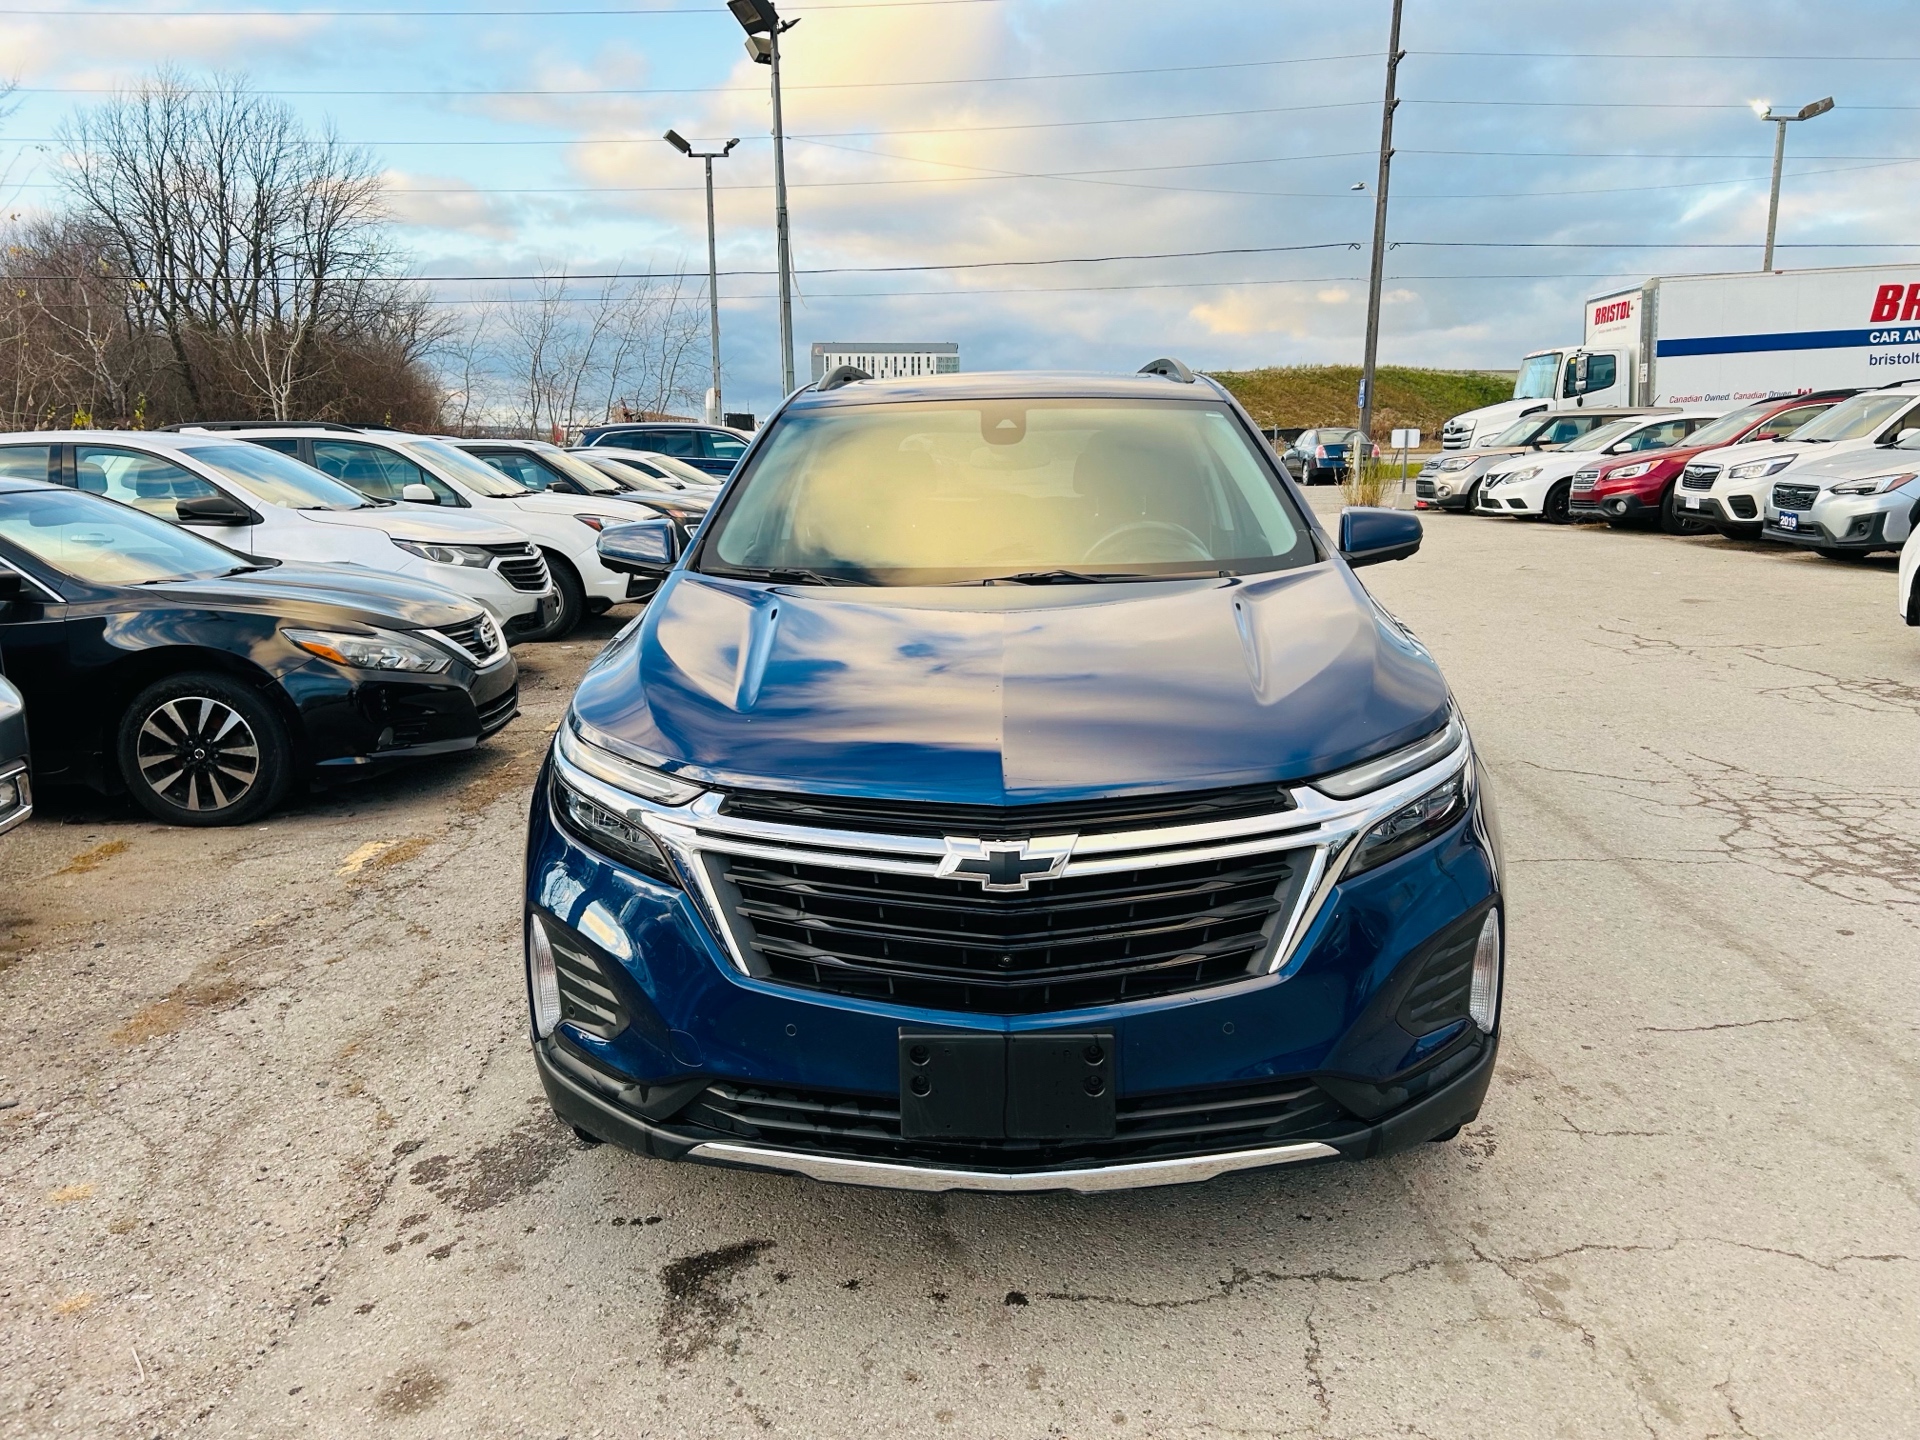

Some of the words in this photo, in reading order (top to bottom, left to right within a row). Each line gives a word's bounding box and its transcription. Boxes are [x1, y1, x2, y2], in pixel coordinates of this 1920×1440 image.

[1594, 300, 1630, 325] BRISTOL
[1869, 330, 1900, 344] CAR
[1669, 395, 1703, 404] Canadian
[1733, 391, 1767, 400] Canadian
[1779, 515, 1798, 528] 2019
